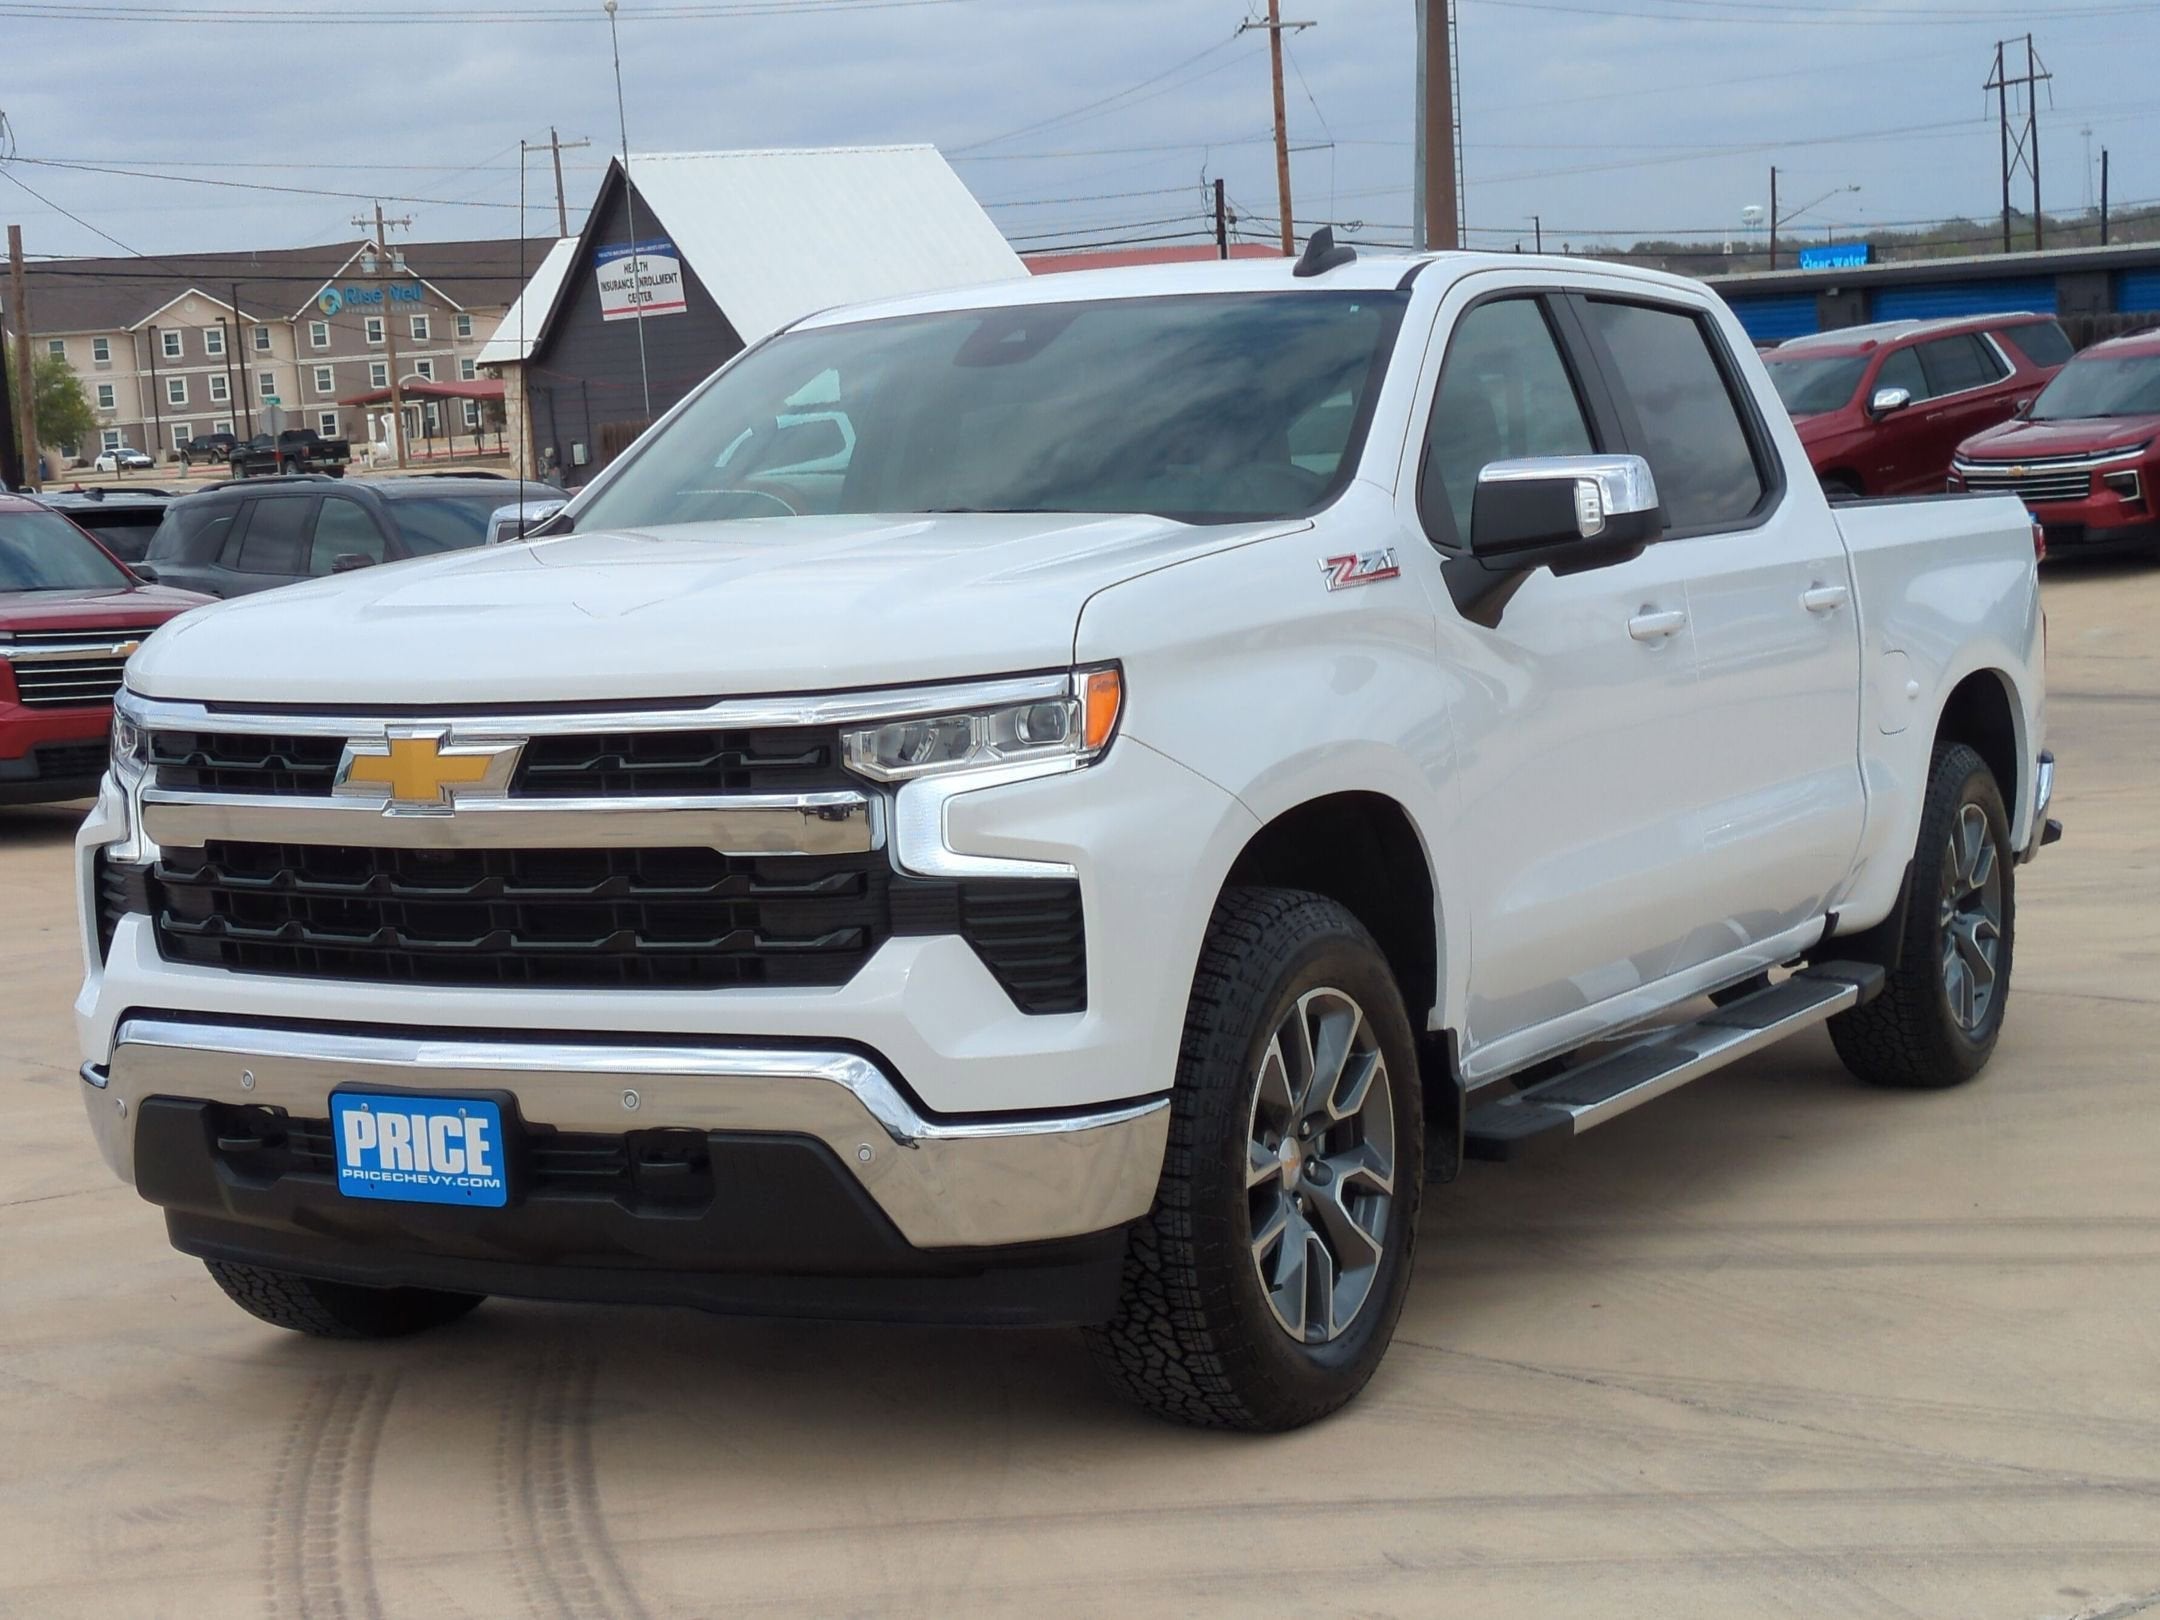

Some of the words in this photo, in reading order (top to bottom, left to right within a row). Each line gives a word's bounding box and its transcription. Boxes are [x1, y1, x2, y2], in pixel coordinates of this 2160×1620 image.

[344, 286, 385, 304] Rise
[1317, 547, 1402, 592] Z71
[342, 1110, 493, 1176] PRICE
[342, 1168, 501, 1189] PRICECHEVY.COM
